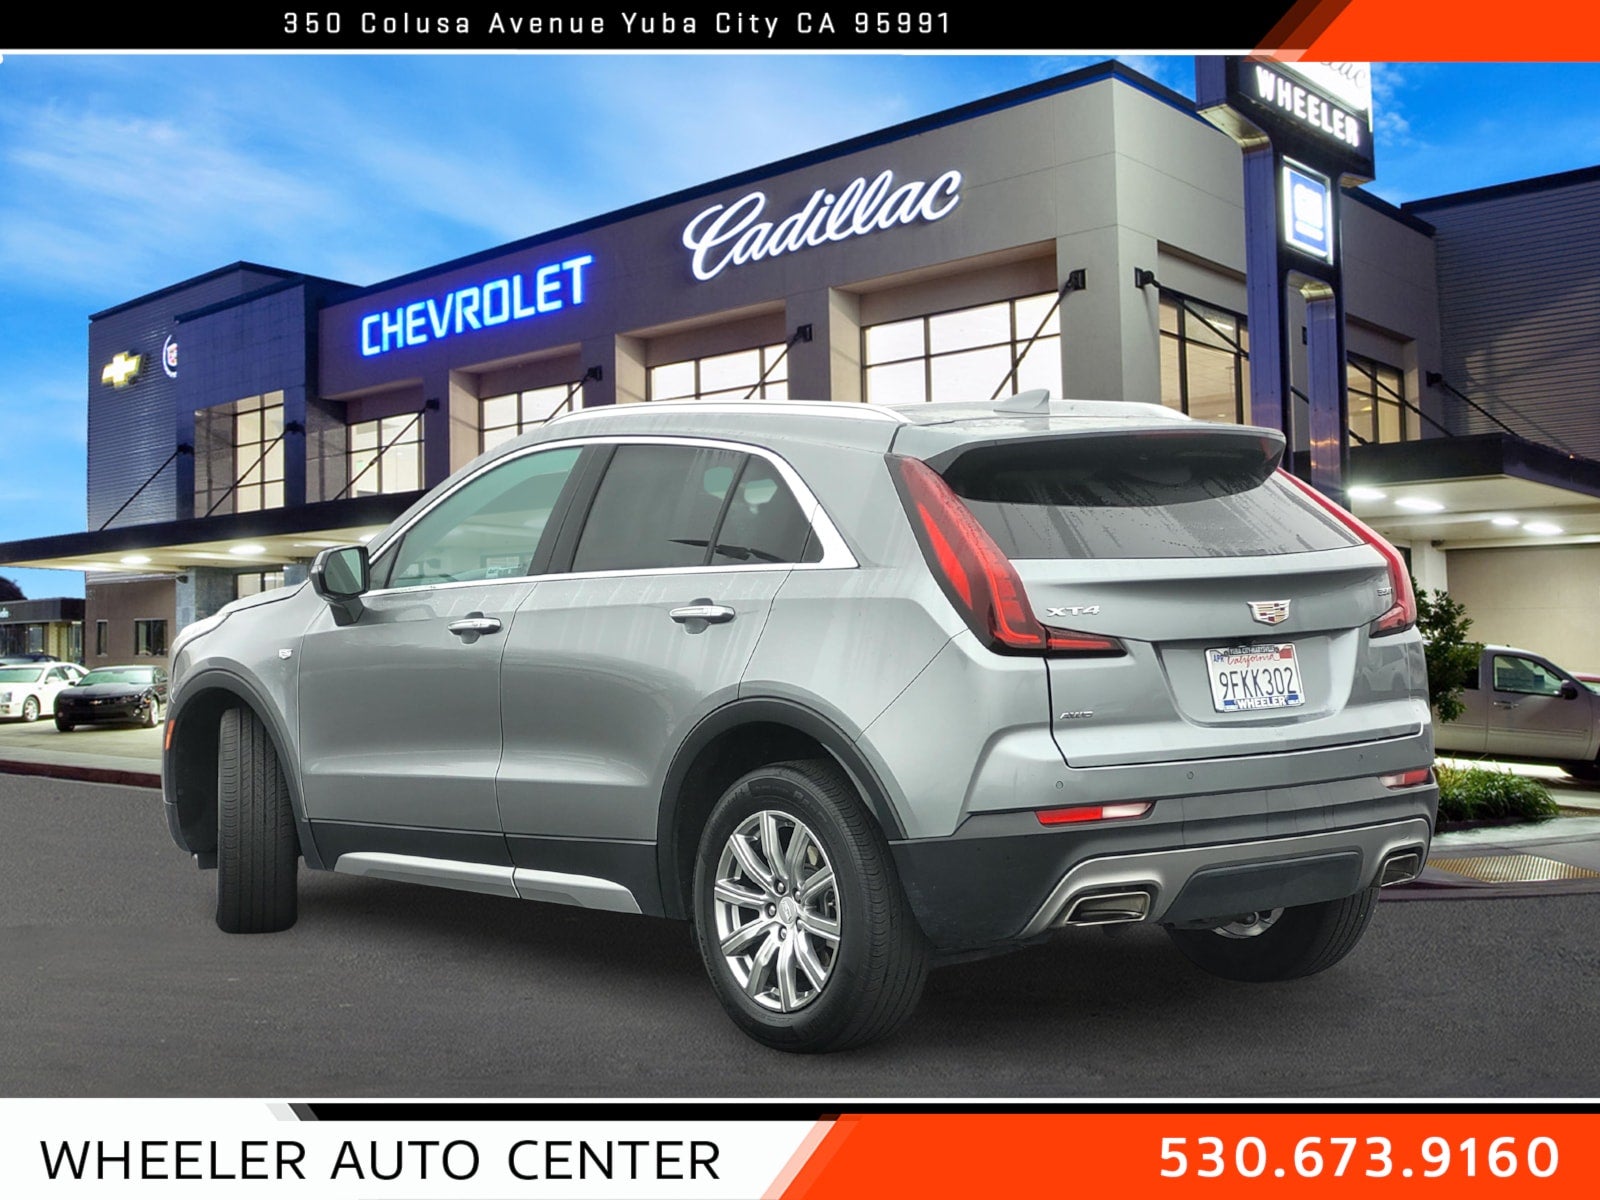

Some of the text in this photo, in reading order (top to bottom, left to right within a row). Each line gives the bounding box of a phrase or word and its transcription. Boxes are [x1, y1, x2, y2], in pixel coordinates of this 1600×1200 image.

[1255, 65, 1359, 147] WHEELER
[682, 169, 962, 281] Cadillac
[362, 255, 593, 356] CHEVROLET
[1046, 605, 1101, 617] XT4
[1227, 653, 1274, 668] California
[1219, 667, 1297, 700] 9FKK302
[1236, 696, 1287, 710] WHEELER
